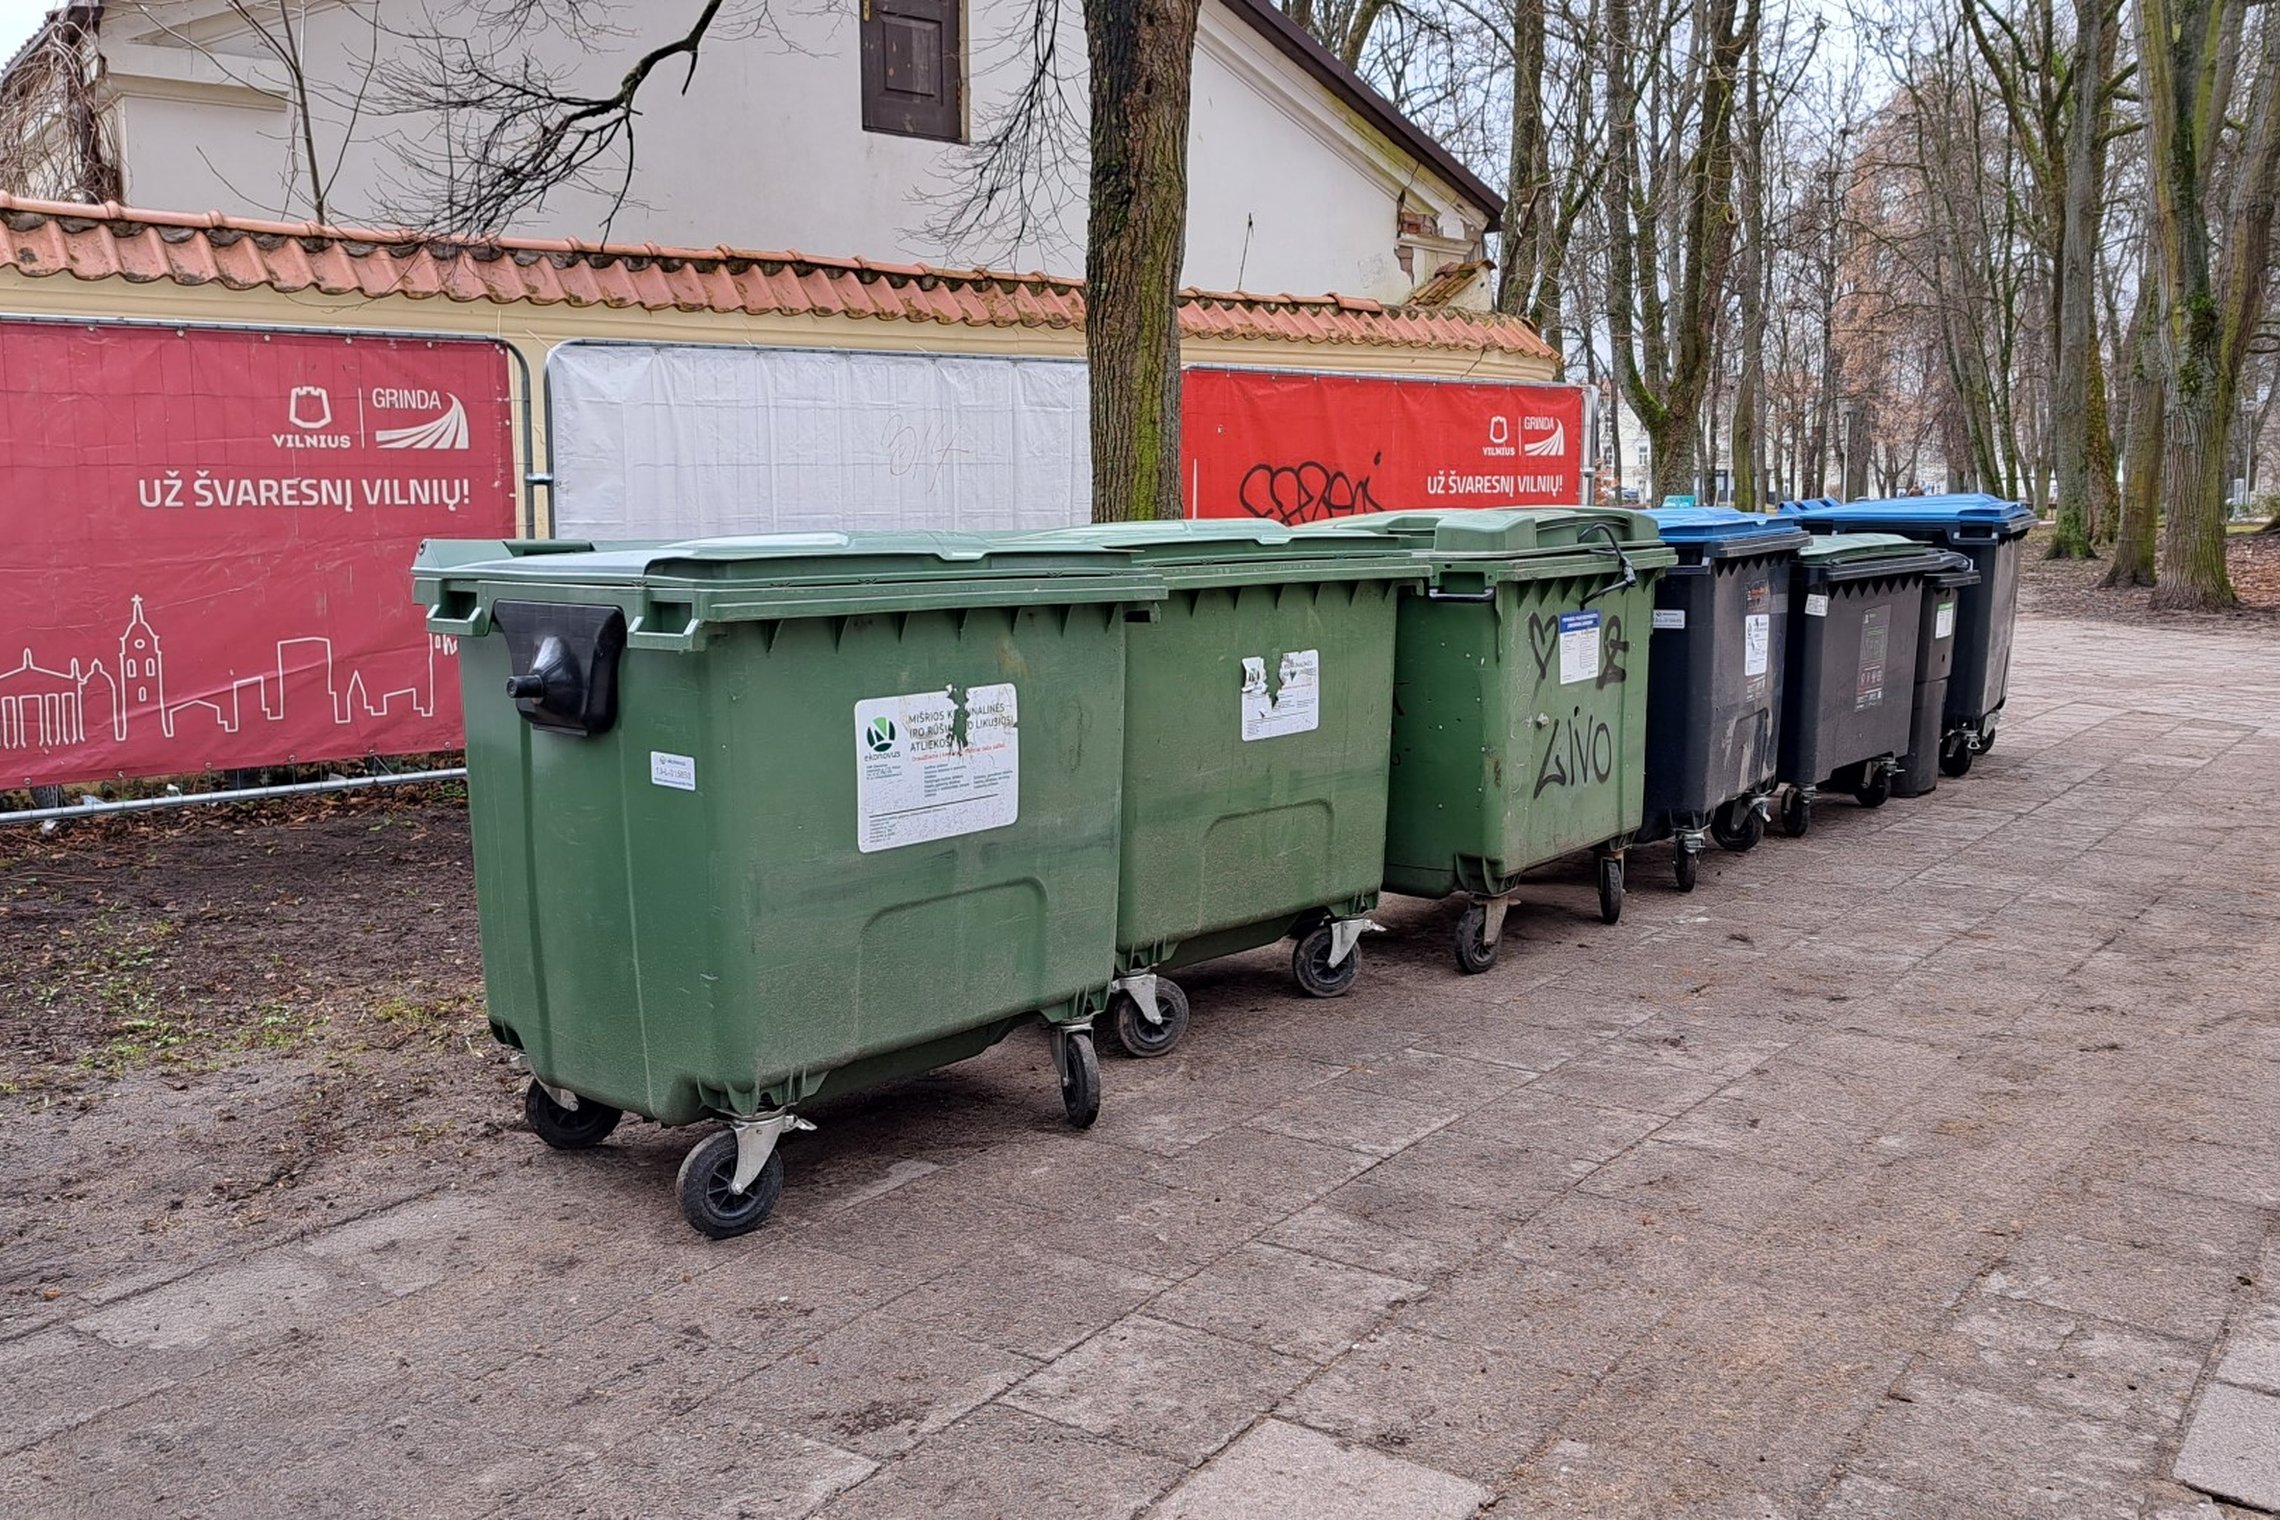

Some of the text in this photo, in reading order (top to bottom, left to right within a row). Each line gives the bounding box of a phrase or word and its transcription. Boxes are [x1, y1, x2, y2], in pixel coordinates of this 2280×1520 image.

[372, 388, 442, 410] GRINDA
[1524, 416, 1555, 430] GRINDA
[272, 434, 351, 448] VILNIUS
[1482, 446, 1516, 456] VILNIUS
[138, 470, 470, 512] UŽ ŠVARESNĮ VILNIŲ!
[1427, 470, 1563, 498] UŽ ŠVARESNĮ VILNIŲ!
[908, 710, 945, 725] MIŠRIOS
